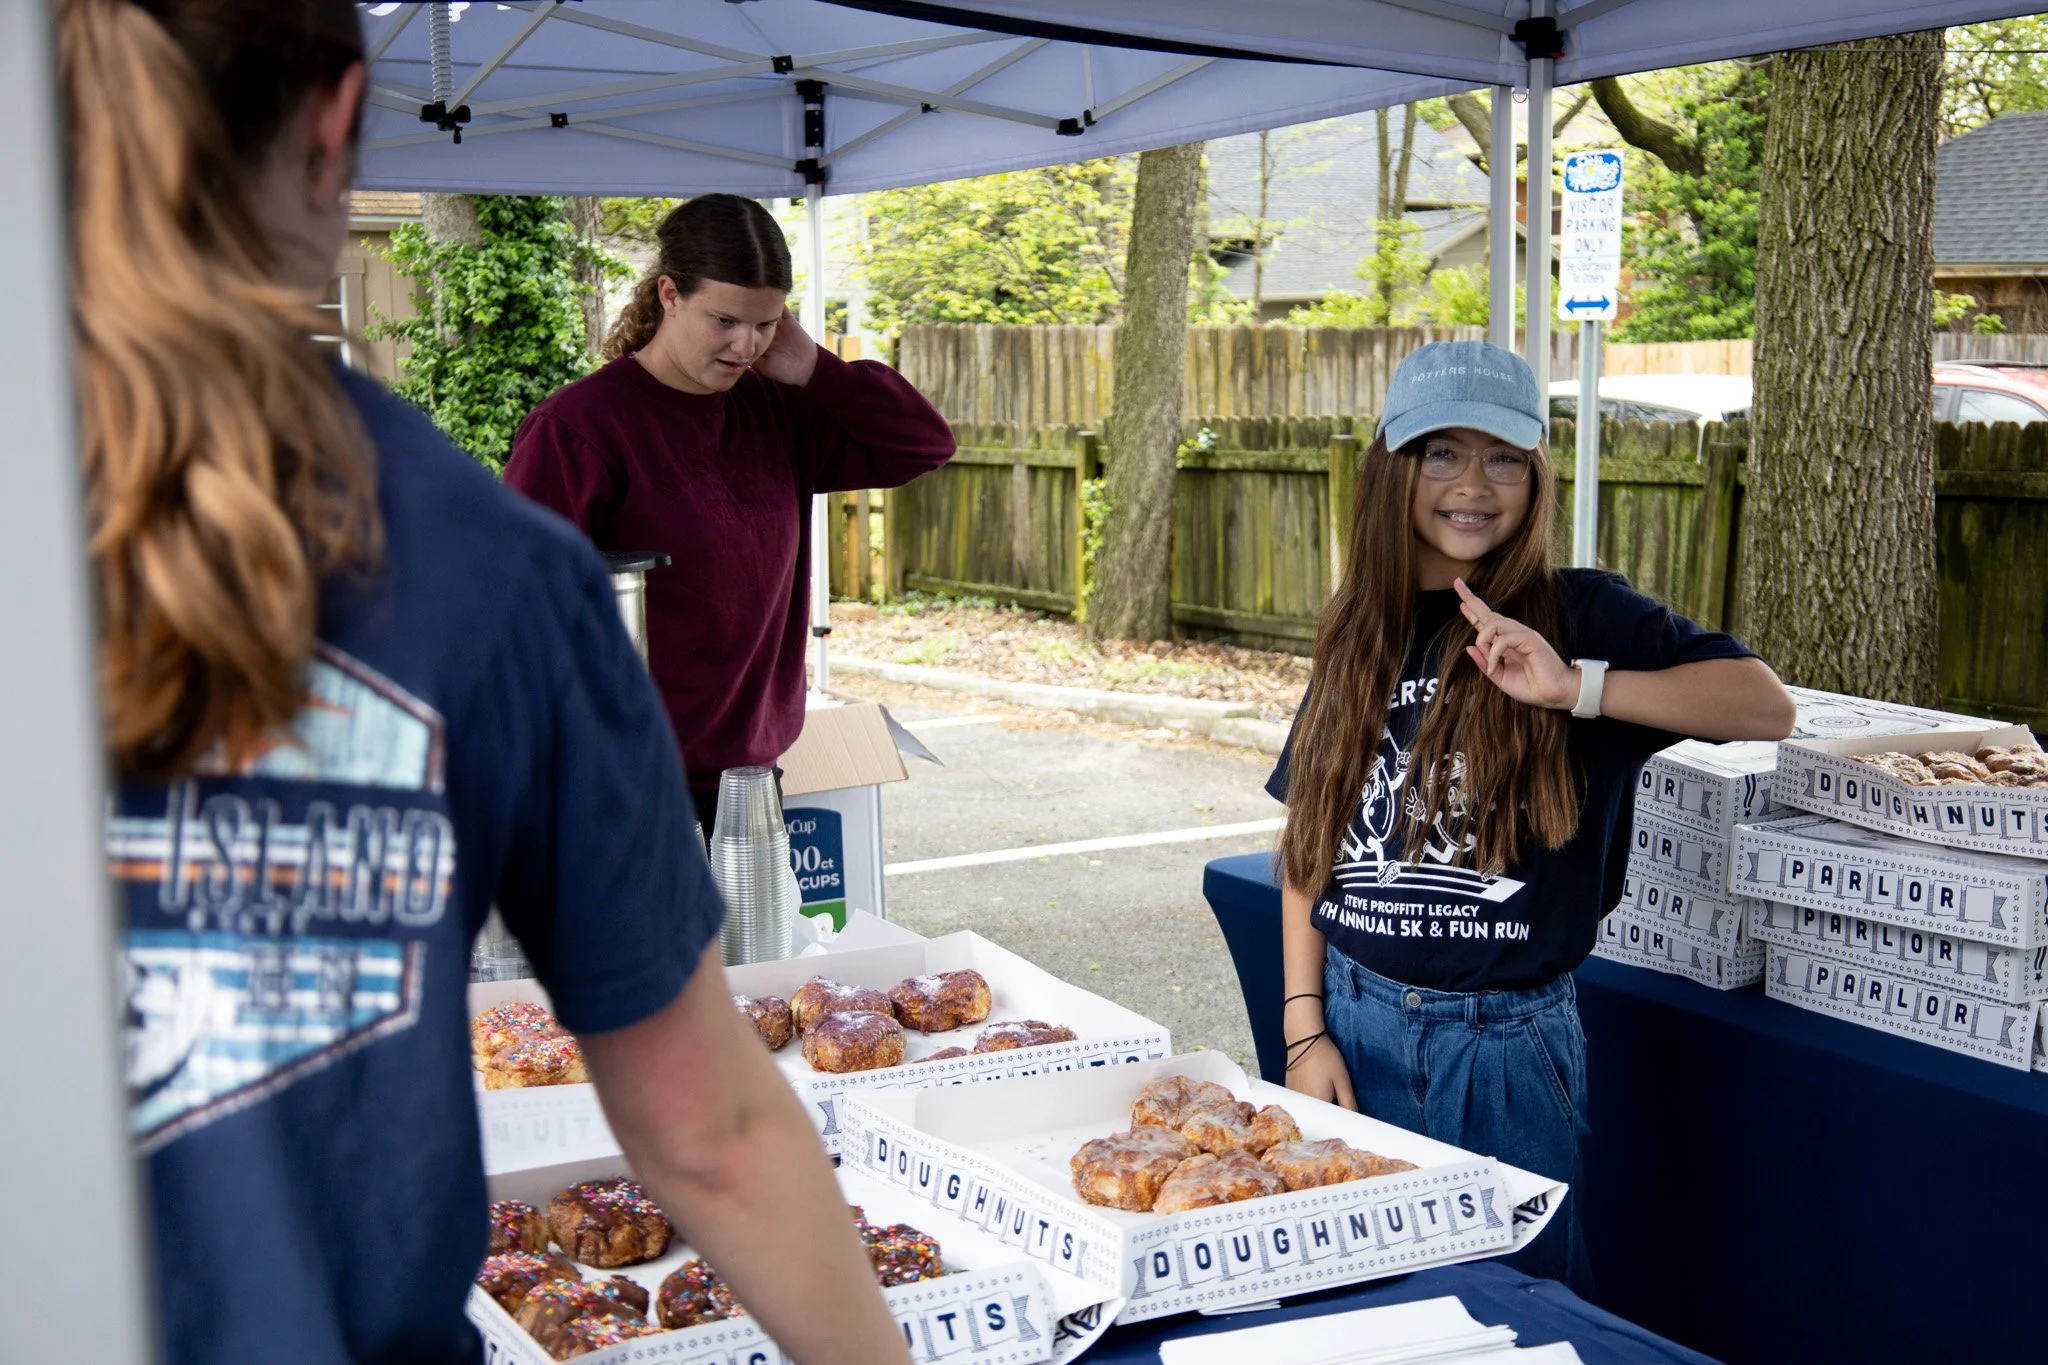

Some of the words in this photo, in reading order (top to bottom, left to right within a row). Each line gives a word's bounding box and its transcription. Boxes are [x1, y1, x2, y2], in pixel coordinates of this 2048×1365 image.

[1569, 197, 1615, 214] VISITOR
[1566, 217, 1616, 233] PARKING
[1574, 238, 1605, 253] ONLY
[1474, 366, 1515, 383] HOUSE
[799, 873, 840, 890] CUPS
[1623, 879, 1683, 915] LOR
[1792, 860, 1953, 909] PARLOR
[1344, 894, 1368, 911] STEVE
[1370, 900, 1424, 916] PROFFITT
[1428, 904, 1480, 917] LEGACY
[1339, 908, 1396, 936] ANNUAL
[1400, 919, 1424, 937] 5K
[1429, 921, 1443, 937] &
[1449, 920, 1489, 939] FUN
[1495, 921, 1530, 941] RUN
[1607, 919, 1664, 950] LOR
[1804, 907, 1952, 961] PARLOR
[1816, 966, 1967, 1025] PARLOR
[878, 1137, 1074, 1252] DOUGHNUTS
[1153, 1192, 1476, 1279] DOUGHNUTS
